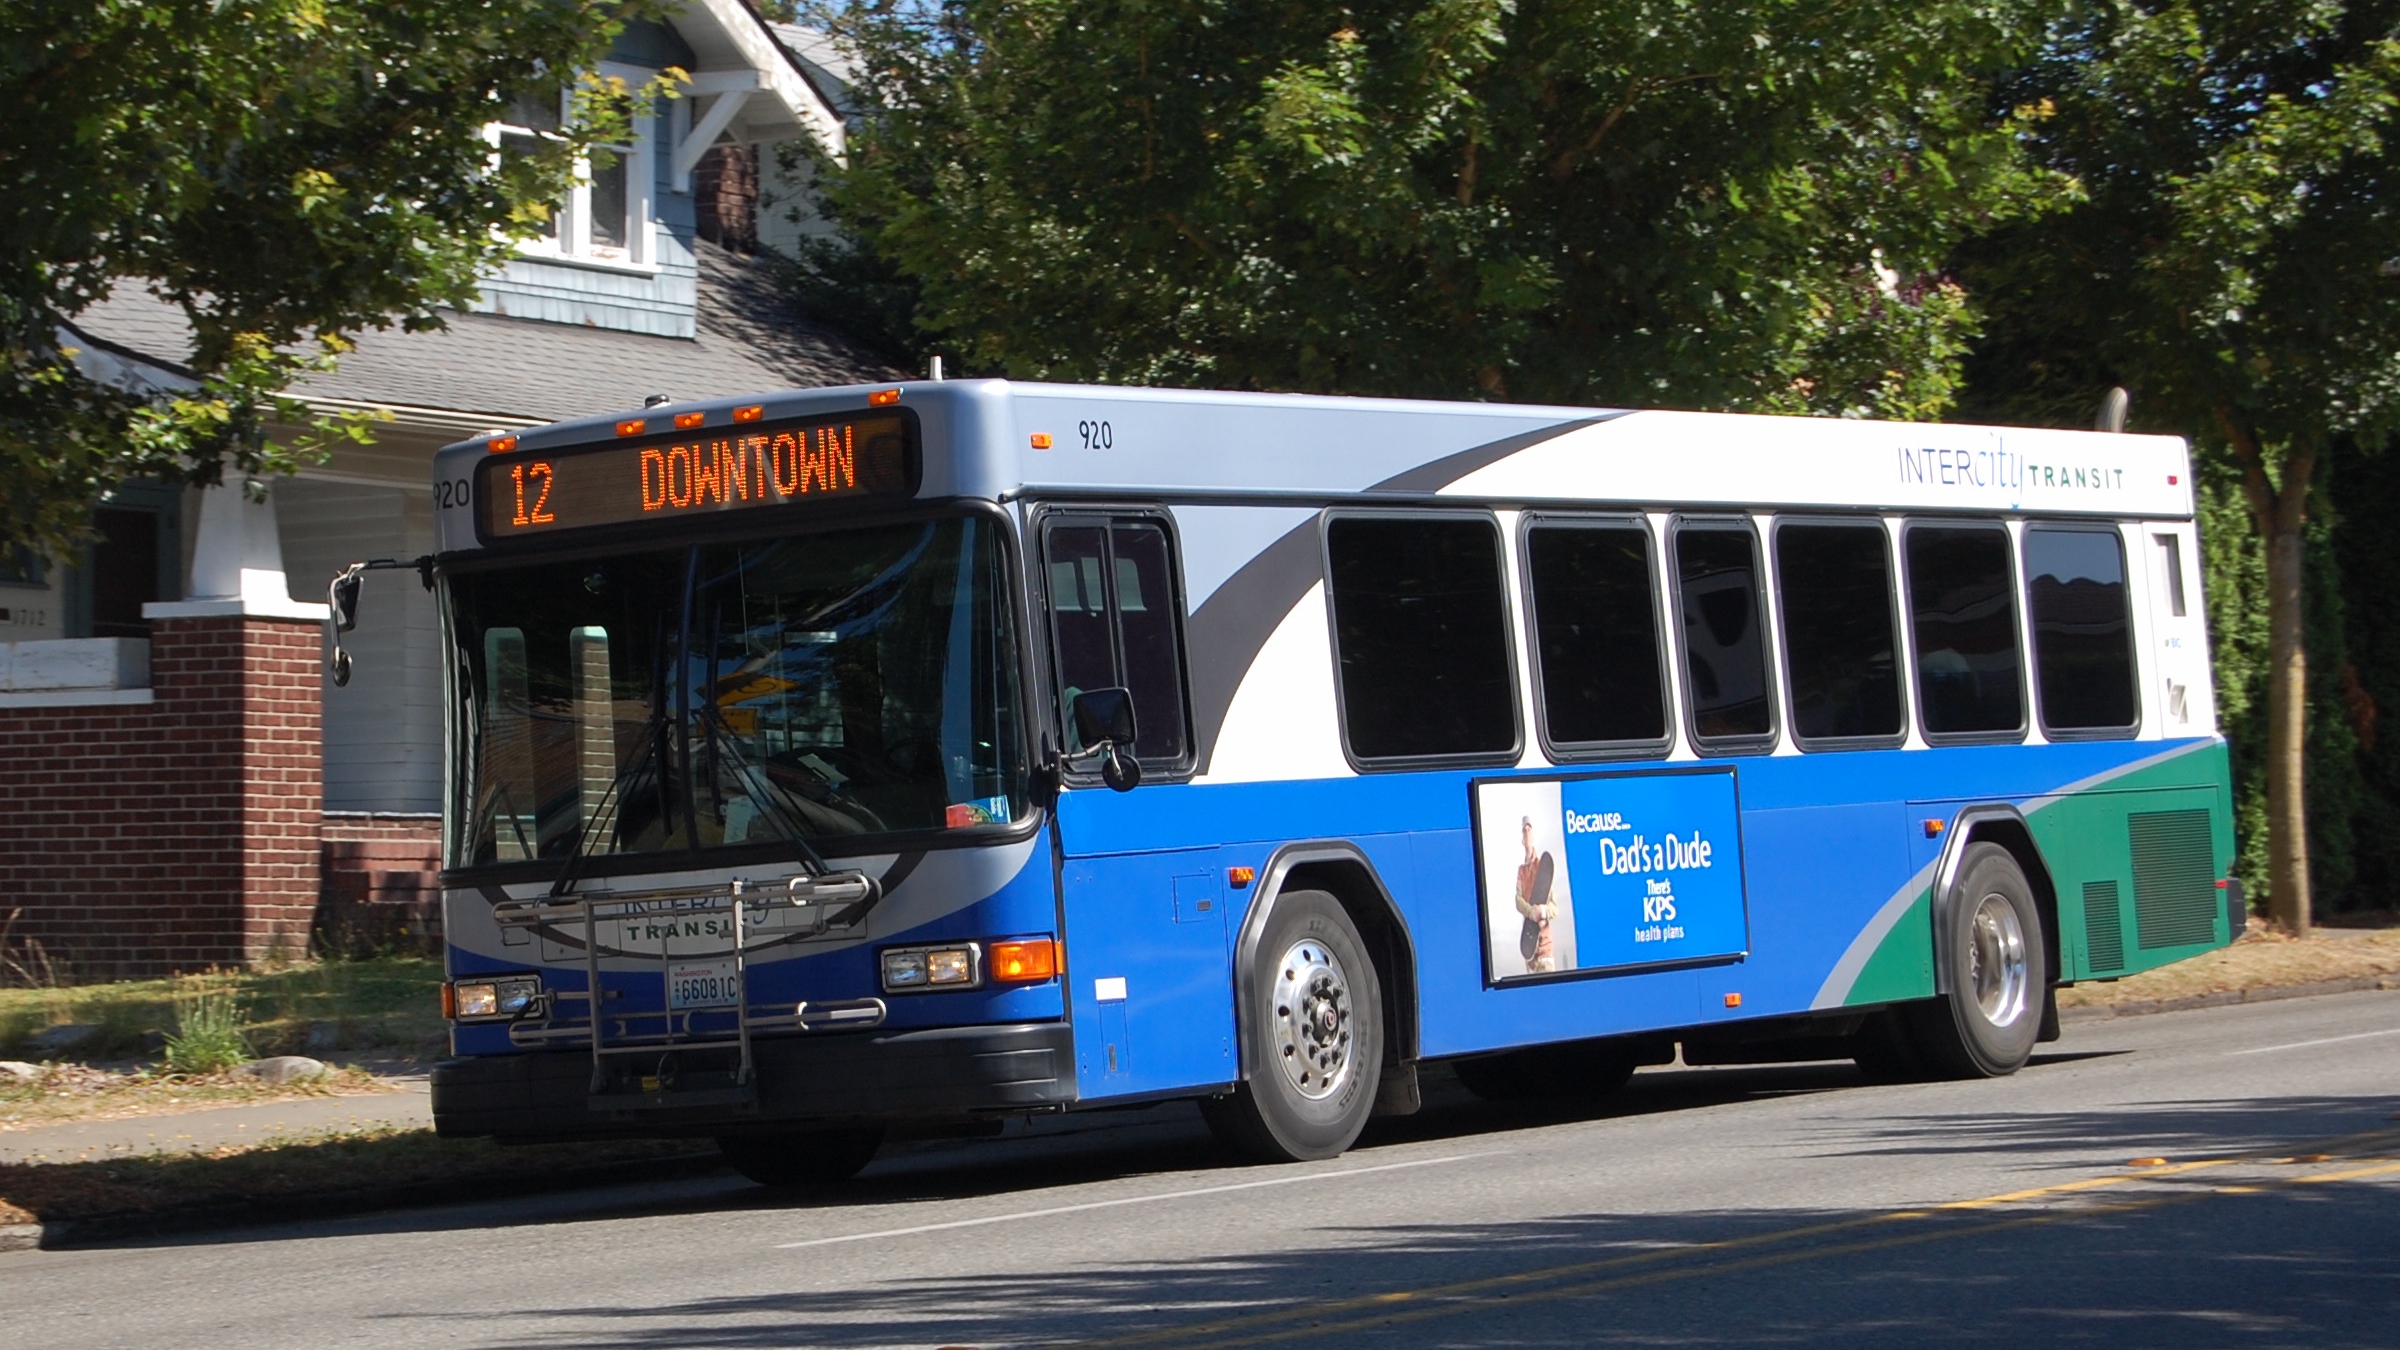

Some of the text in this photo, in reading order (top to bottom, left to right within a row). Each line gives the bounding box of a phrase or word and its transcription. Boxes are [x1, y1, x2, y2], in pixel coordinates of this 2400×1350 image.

[1079, 420, 1112, 449] 920
[512, 425, 855, 525] 12 DOWNTOWN
[2028, 465, 2123, 489] TRANSIT
[433, 478, 470, 511] 920
[1566, 809, 1631, 834] Because...
[1600, 830, 1712, 875] Dad's a Dude
[1646, 878, 1671, 895] There's
[1643, 895, 1676, 922] KPS
[627, 918, 747, 940] TRANSI
[1635, 924, 1685, 943] health plans
[682, 976, 736, 1000] 66081C
